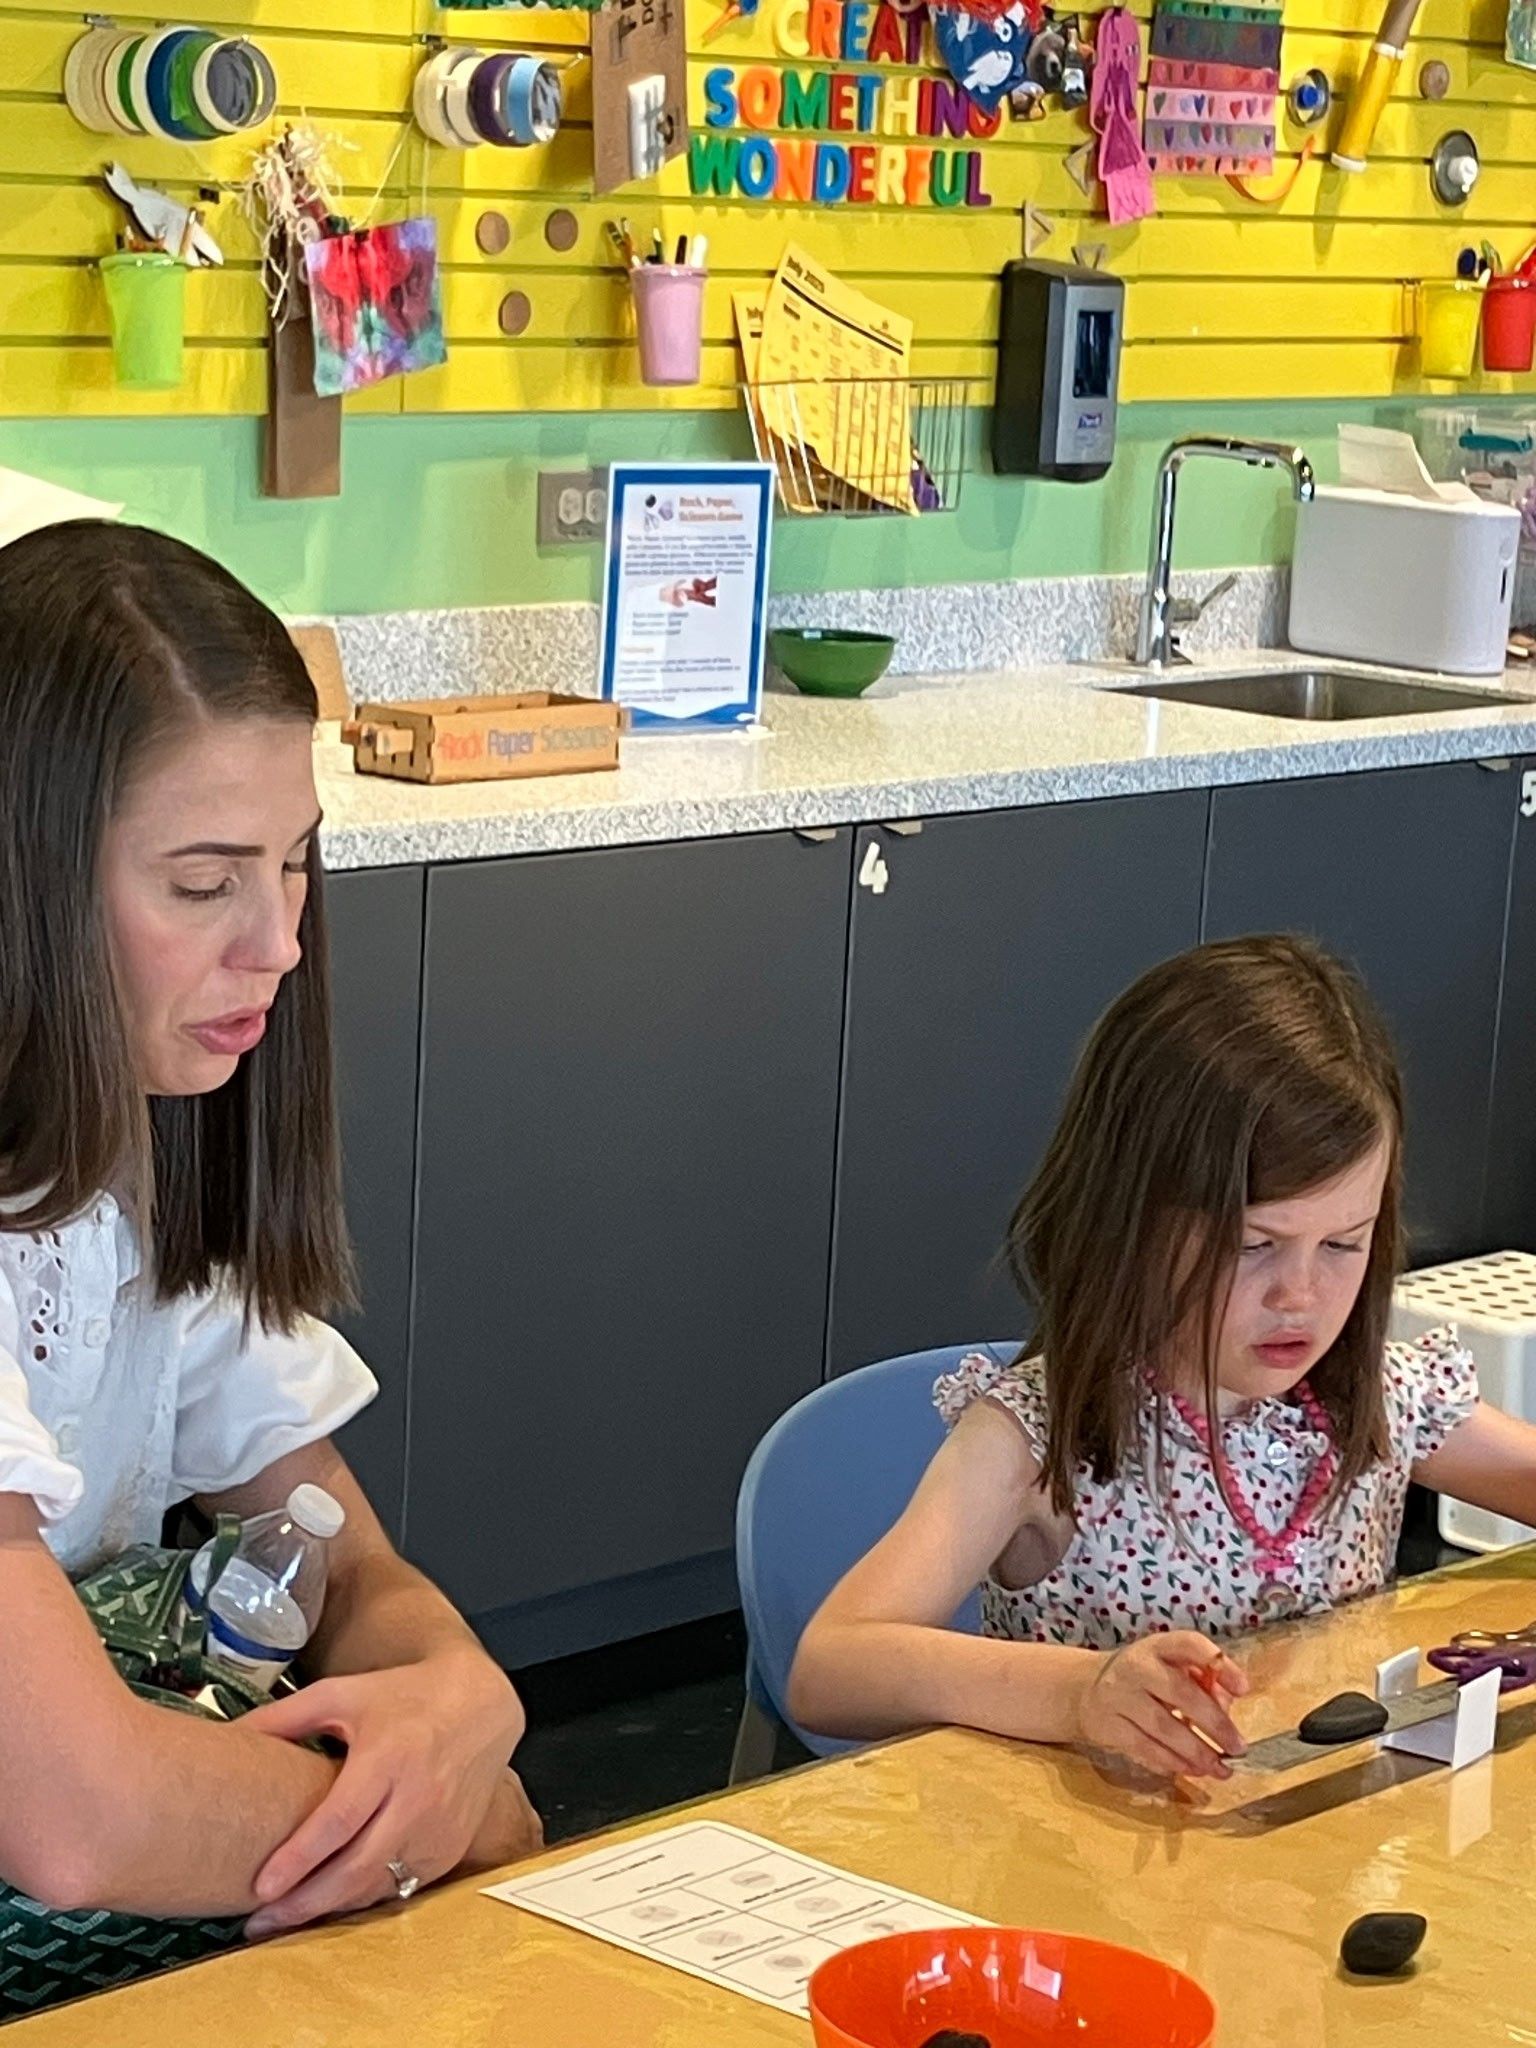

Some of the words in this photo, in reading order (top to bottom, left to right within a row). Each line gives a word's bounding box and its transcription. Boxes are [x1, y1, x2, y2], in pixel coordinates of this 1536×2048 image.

[774, 0, 943, 67] CREAT
[688, 136, 992, 207] WONDERFUL
[487, 728, 537, 764] Paper
[859, 841, 889, 894] 4
